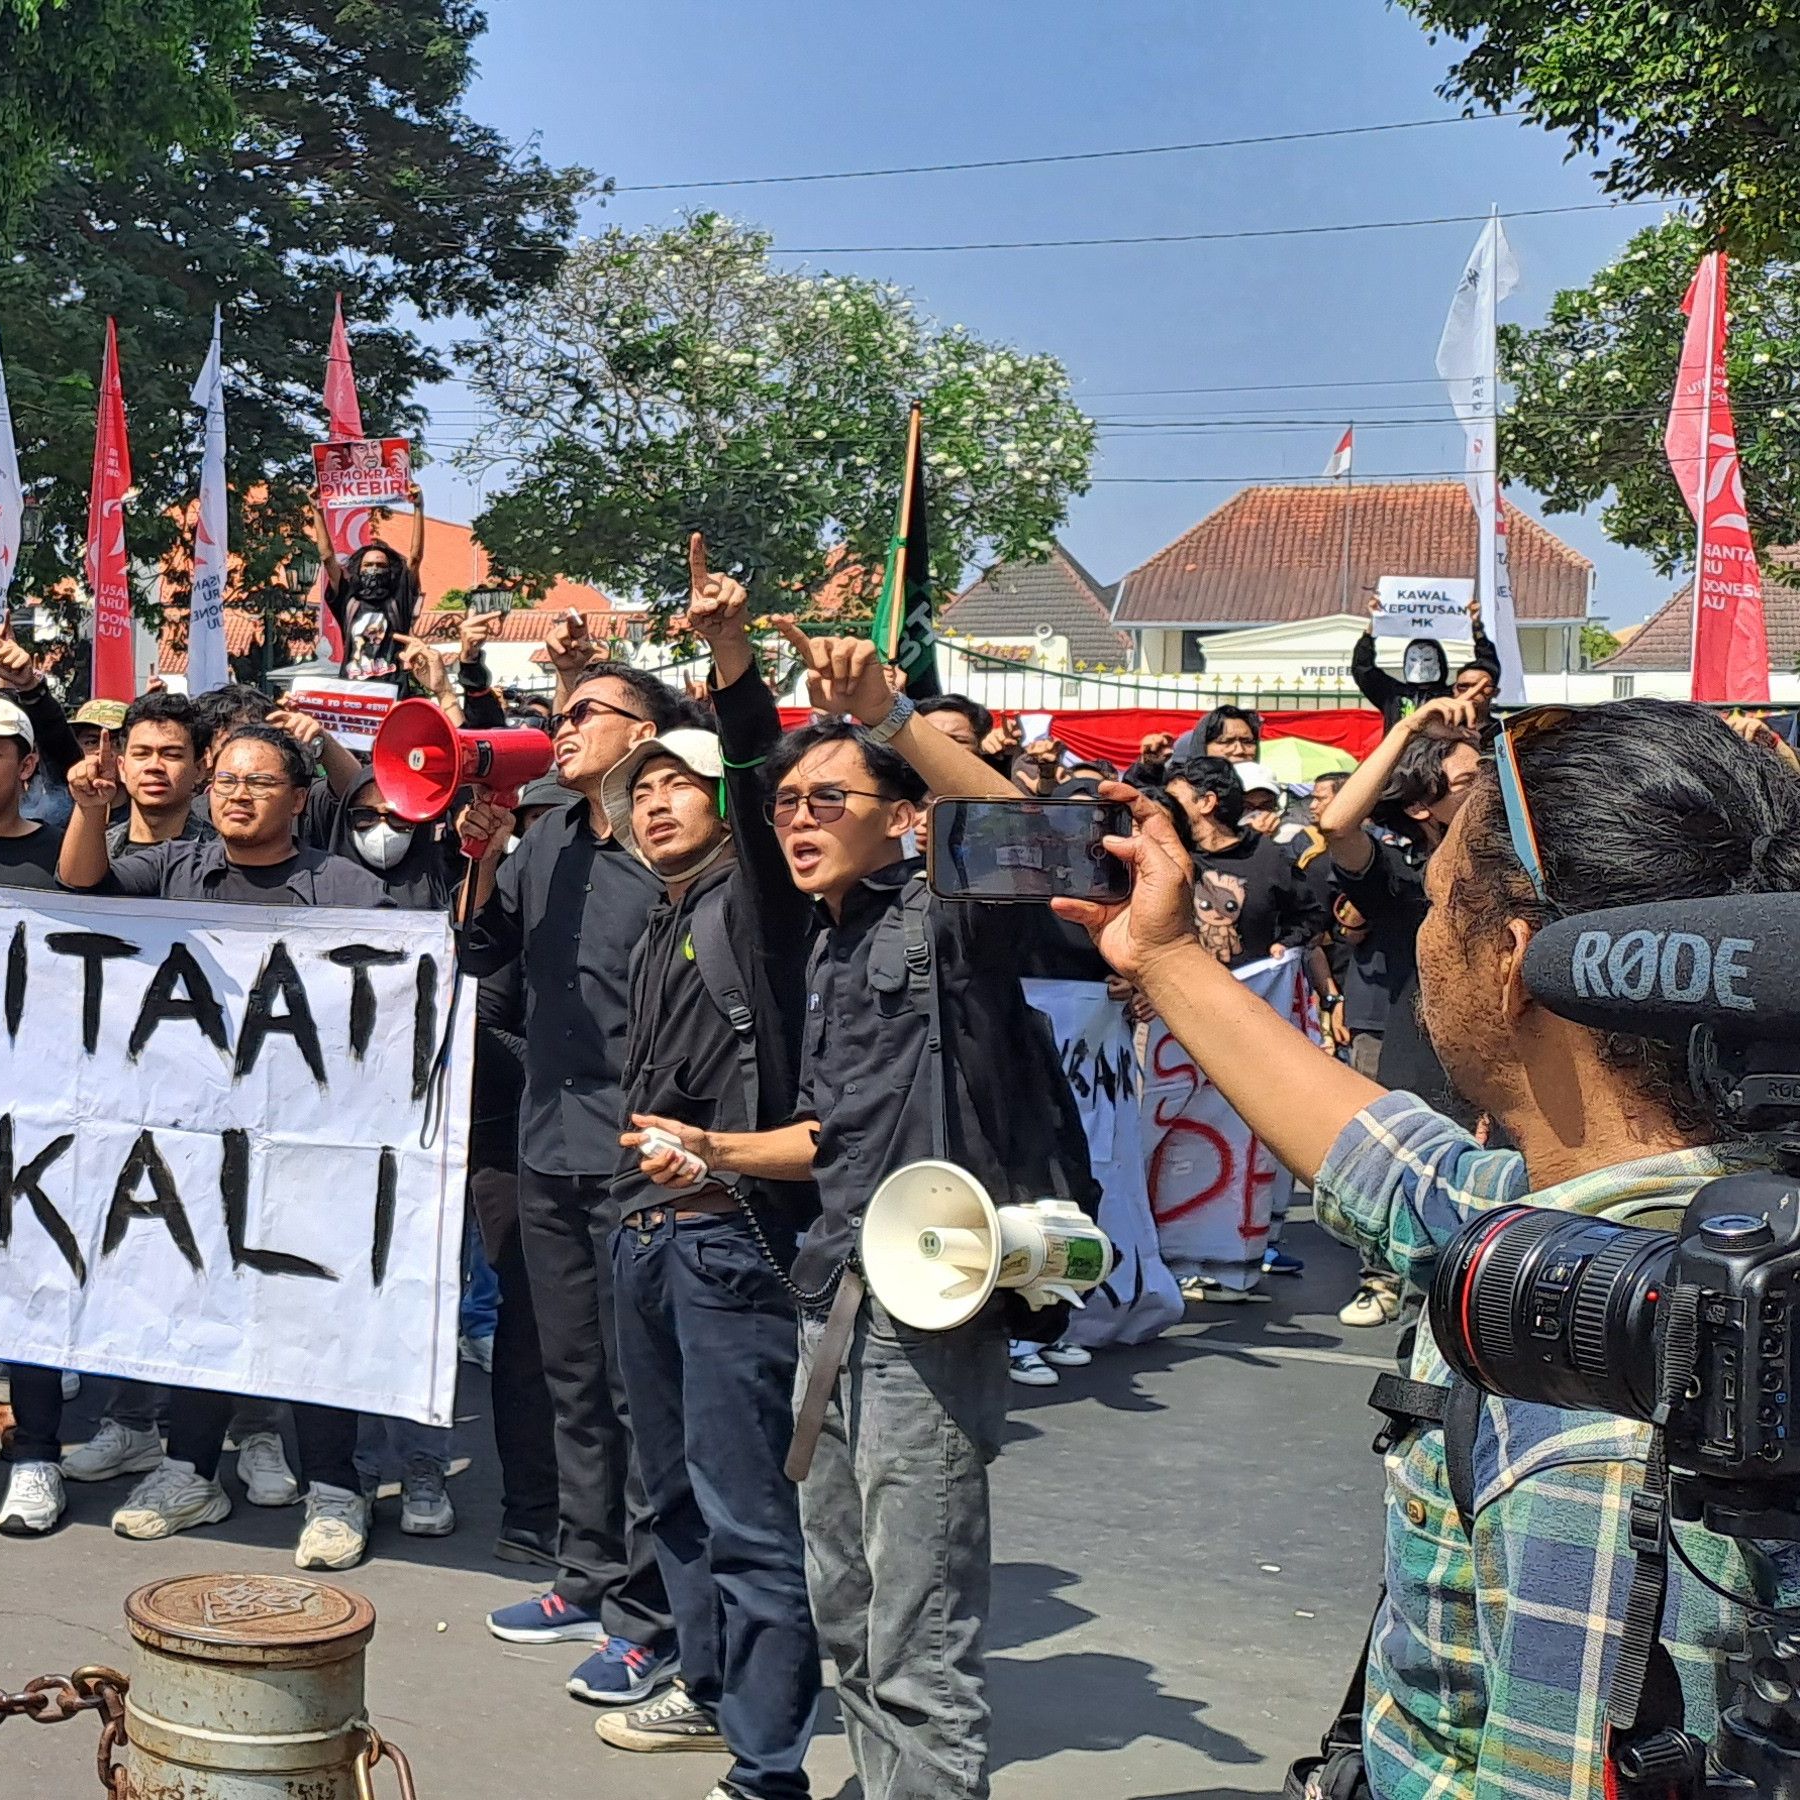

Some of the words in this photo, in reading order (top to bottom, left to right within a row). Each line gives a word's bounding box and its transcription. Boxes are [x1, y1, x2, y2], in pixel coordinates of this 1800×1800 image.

[320, 467, 408, 482] DEMOKRASI
[321, 480, 409, 497] DIKEBIRI
[1397, 590, 1450, 601] KAWAL
[1380, 603, 1467, 615] KEPUTUSAN
[1411, 618, 1433, 628] MK
[1572, 929, 1756, 1011] RØDE
